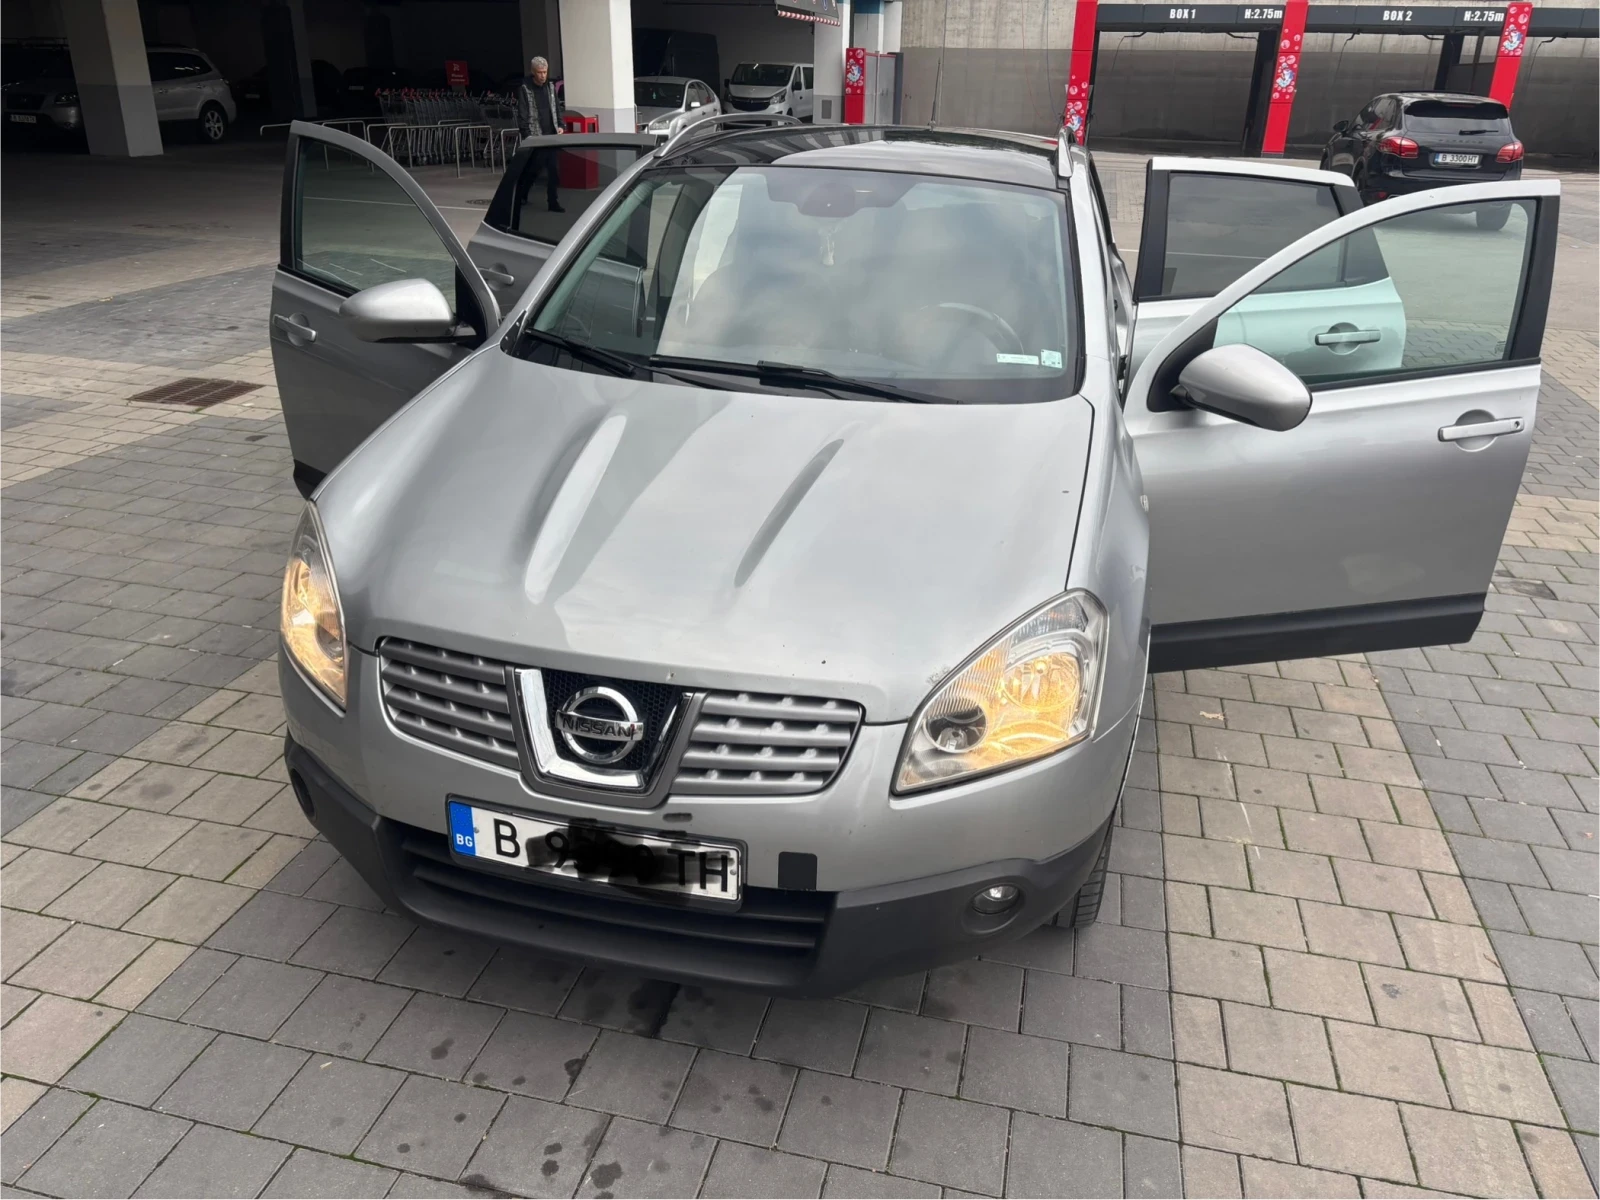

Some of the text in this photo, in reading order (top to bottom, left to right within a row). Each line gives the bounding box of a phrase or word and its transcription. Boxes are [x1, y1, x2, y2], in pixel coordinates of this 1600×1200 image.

[1169, 8, 1197, 19] BOX 1
[1244, 8, 1283, 19] H:2.75m
[1382, 10, 1413, 21] BOX 2
[1463, 10, 1505, 22] H:2.75m
[562, 717, 633, 738] NISSAN
[456, 833, 473, 848] BG
[493, 818, 521, 858] B
[667, 848, 728, 893] TH
